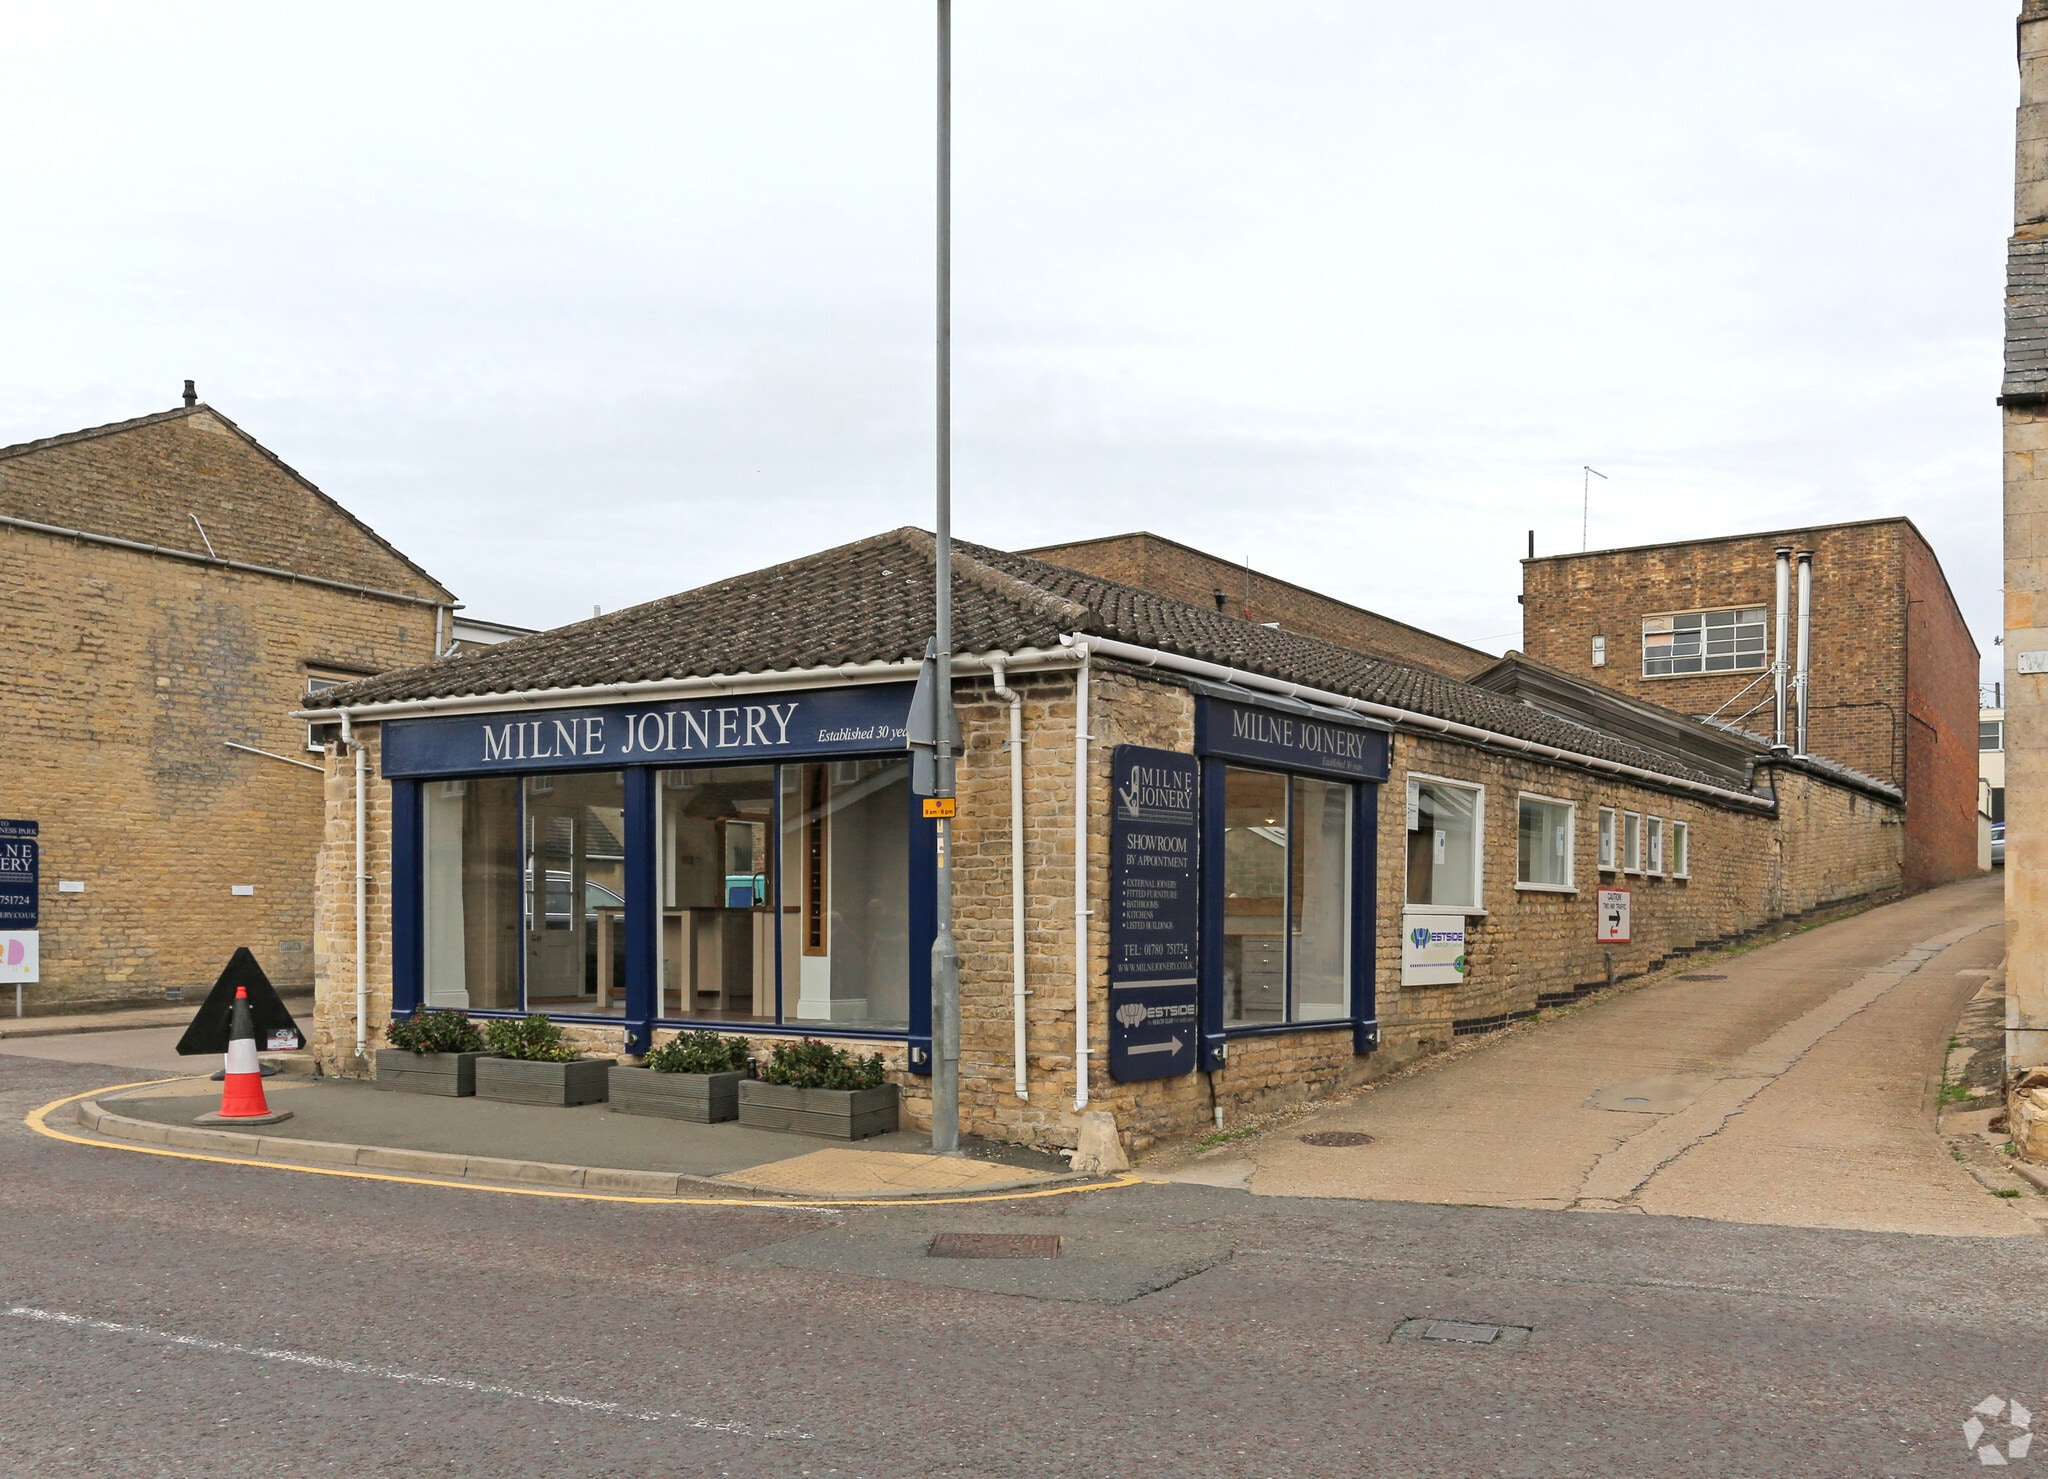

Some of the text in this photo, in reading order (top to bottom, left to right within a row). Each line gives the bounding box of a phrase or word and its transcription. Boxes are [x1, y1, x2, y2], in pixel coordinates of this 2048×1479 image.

[482, 703, 799, 761] MILNE JOINERY
[818, 726, 875, 742] Established
[876, 725, 889, 739] 30
[1232, 709, 1366, 759] MILNE JOINERY
[1140, 767, 1193, 809] MILNE JOINERY
[1127, 833, 1187, 853] SHOWROOM
[1126, 854, 1188, 869] BY APPOINTMENT
[1126, 878, 1155, 888] EXTERNAL
[1126, 889, 1178, 899] FITTED FURNITURE
[1126, 900, 1159, 909] BATHROOMS
[1126, 910, 1153, 919] KITCHENS
[1126, 921, 1174, 930] LISTED BUILDINGS
[1124, 943, 1188, 956] TEL: 01780 751724
